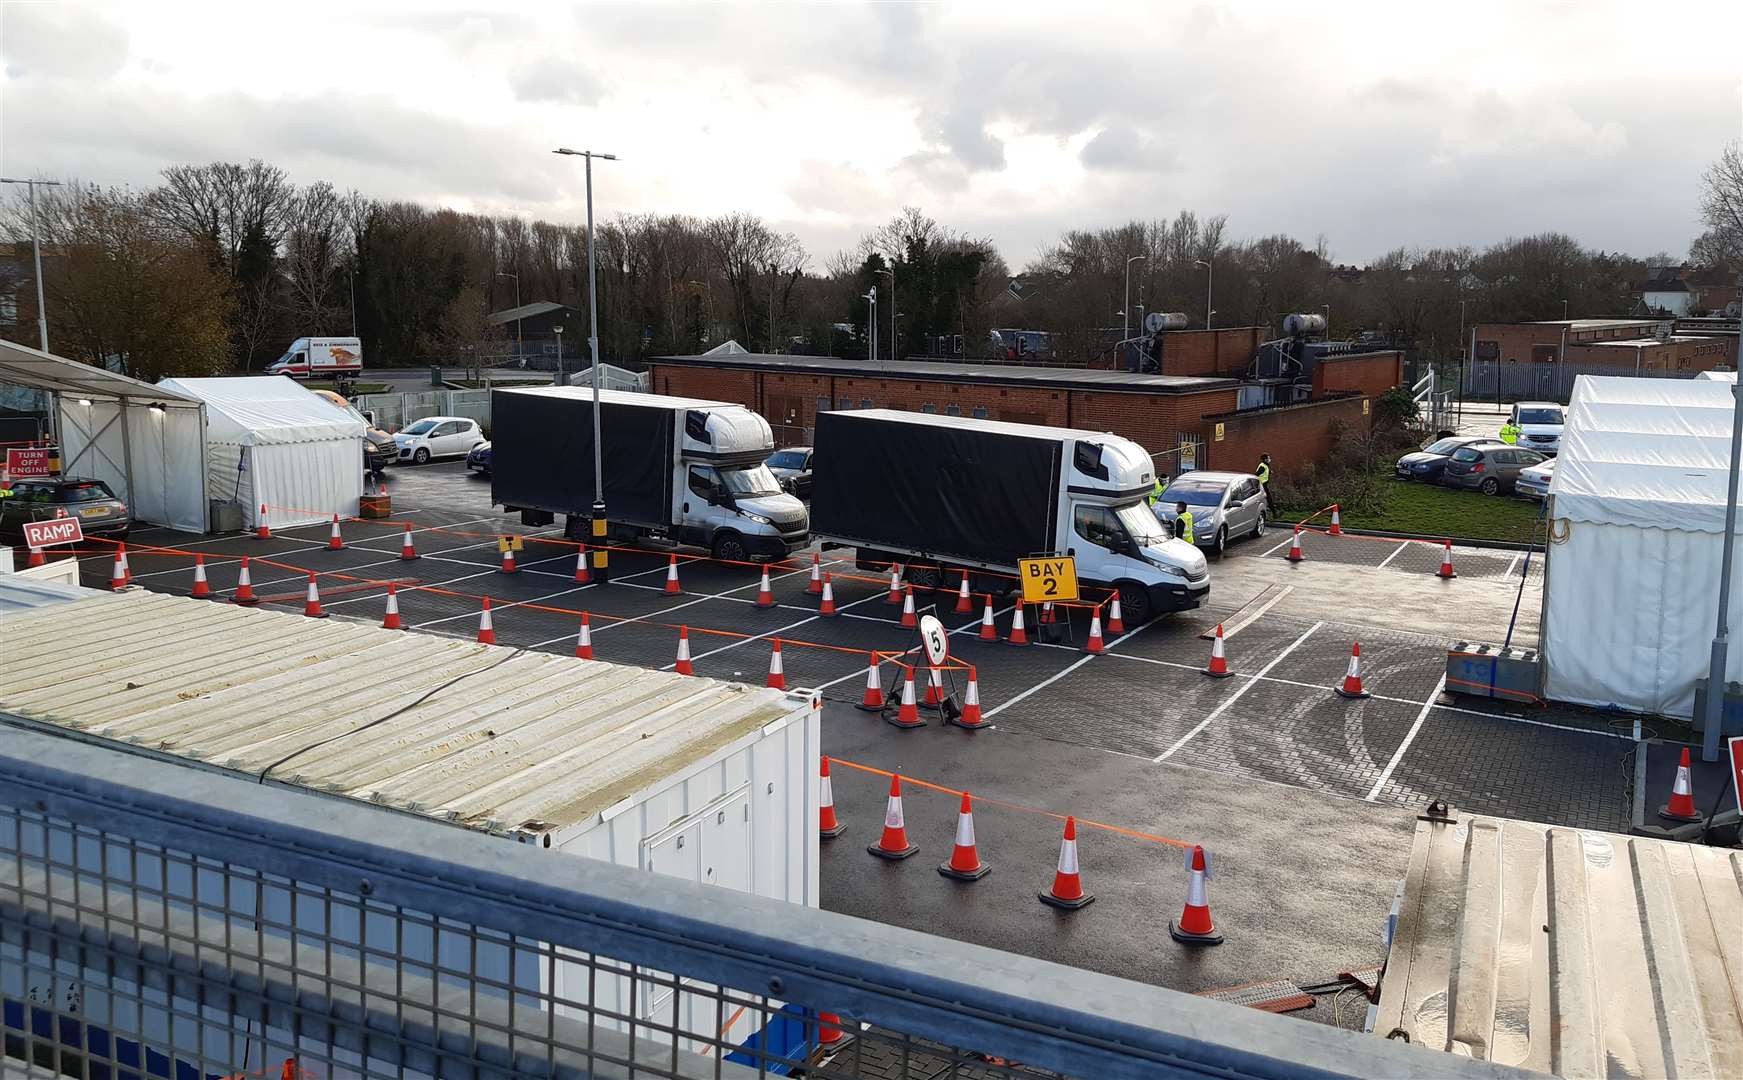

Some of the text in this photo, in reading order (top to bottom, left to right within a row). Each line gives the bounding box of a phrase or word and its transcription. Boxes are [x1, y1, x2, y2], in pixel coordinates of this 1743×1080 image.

[17, 451, 44, 459] TURN
[11, 466, 49, 474] ENGINE
[30, 523, 75, 542] RAMP
[1029, 562, 1065, 578] BAY
[1042, 577, 1058, 596] 2
[930, 630, 941, 653] 5
